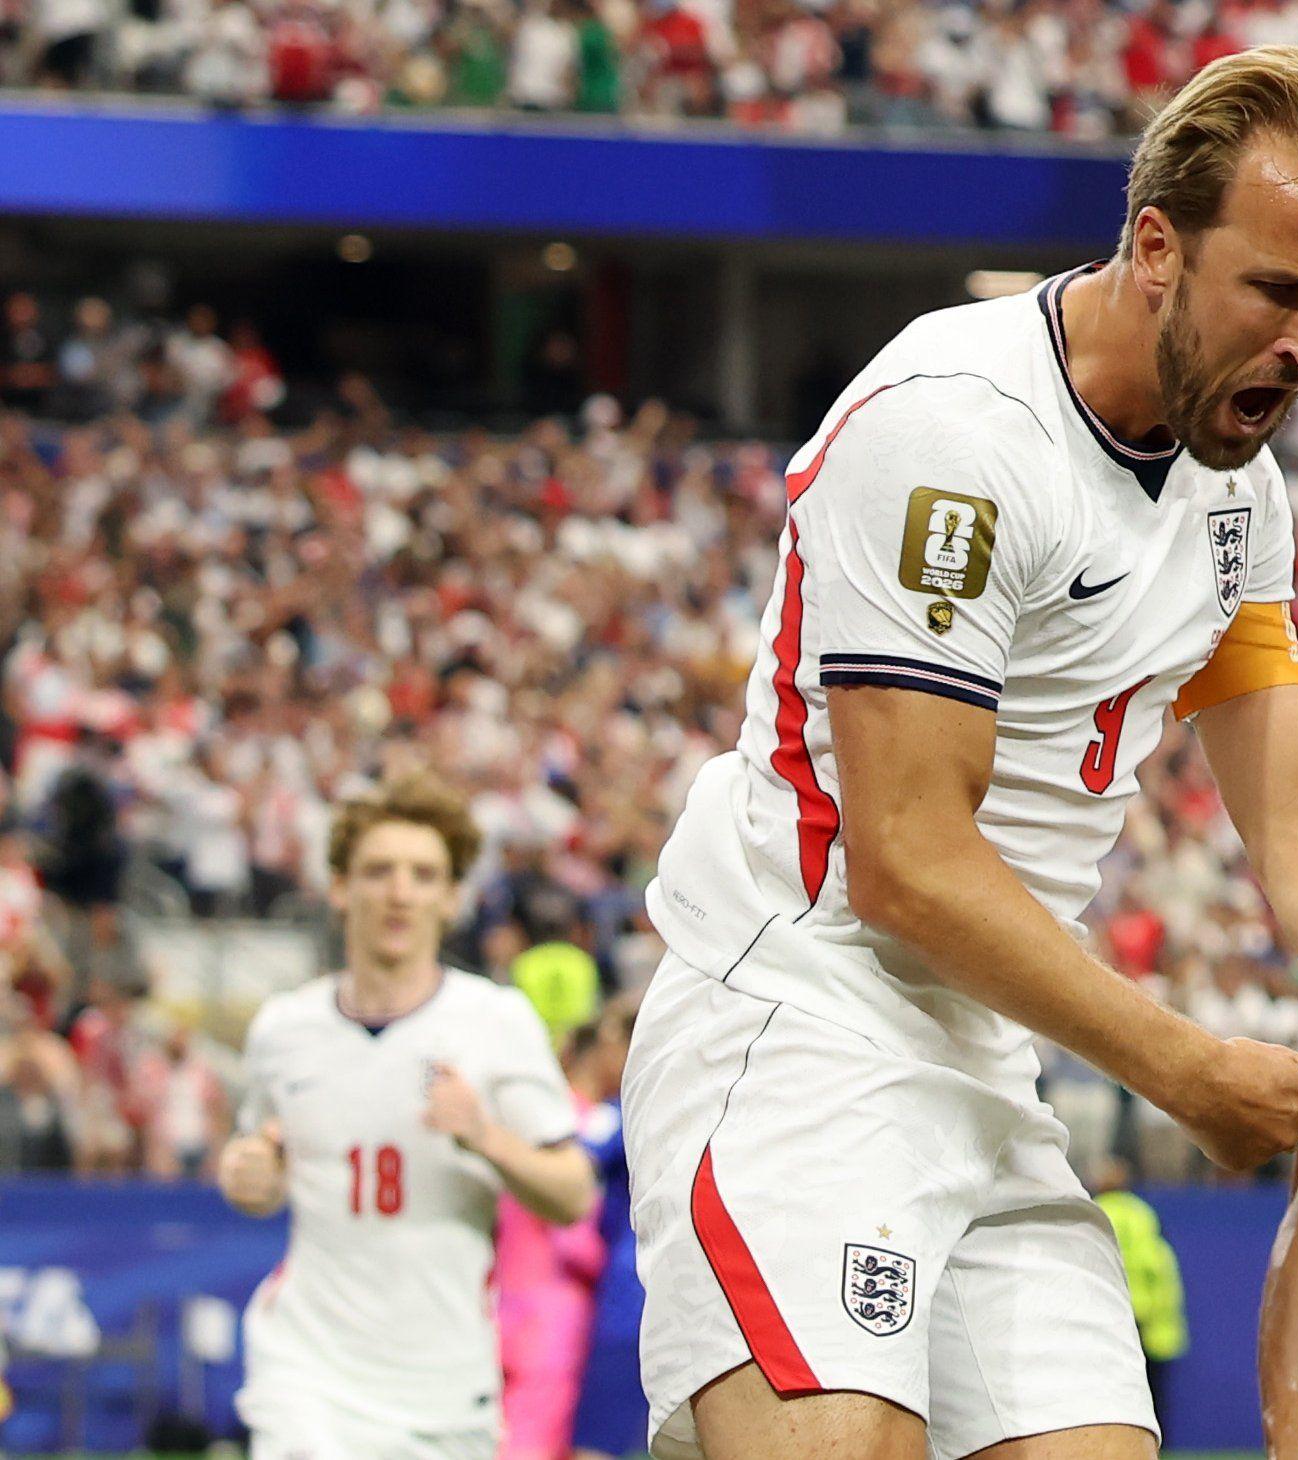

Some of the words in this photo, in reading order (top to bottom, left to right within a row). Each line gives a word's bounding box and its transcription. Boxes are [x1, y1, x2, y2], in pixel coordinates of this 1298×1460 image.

[936, 553, 957, 564] FIFA
[922, 566, 950, 578] WORLD
[950, 571, 966, 580] CUP
[920, 574, 964, 591] 2026
[1079, 674, 1158, 796] 9
[346, 1143, 403, 1216] 18
